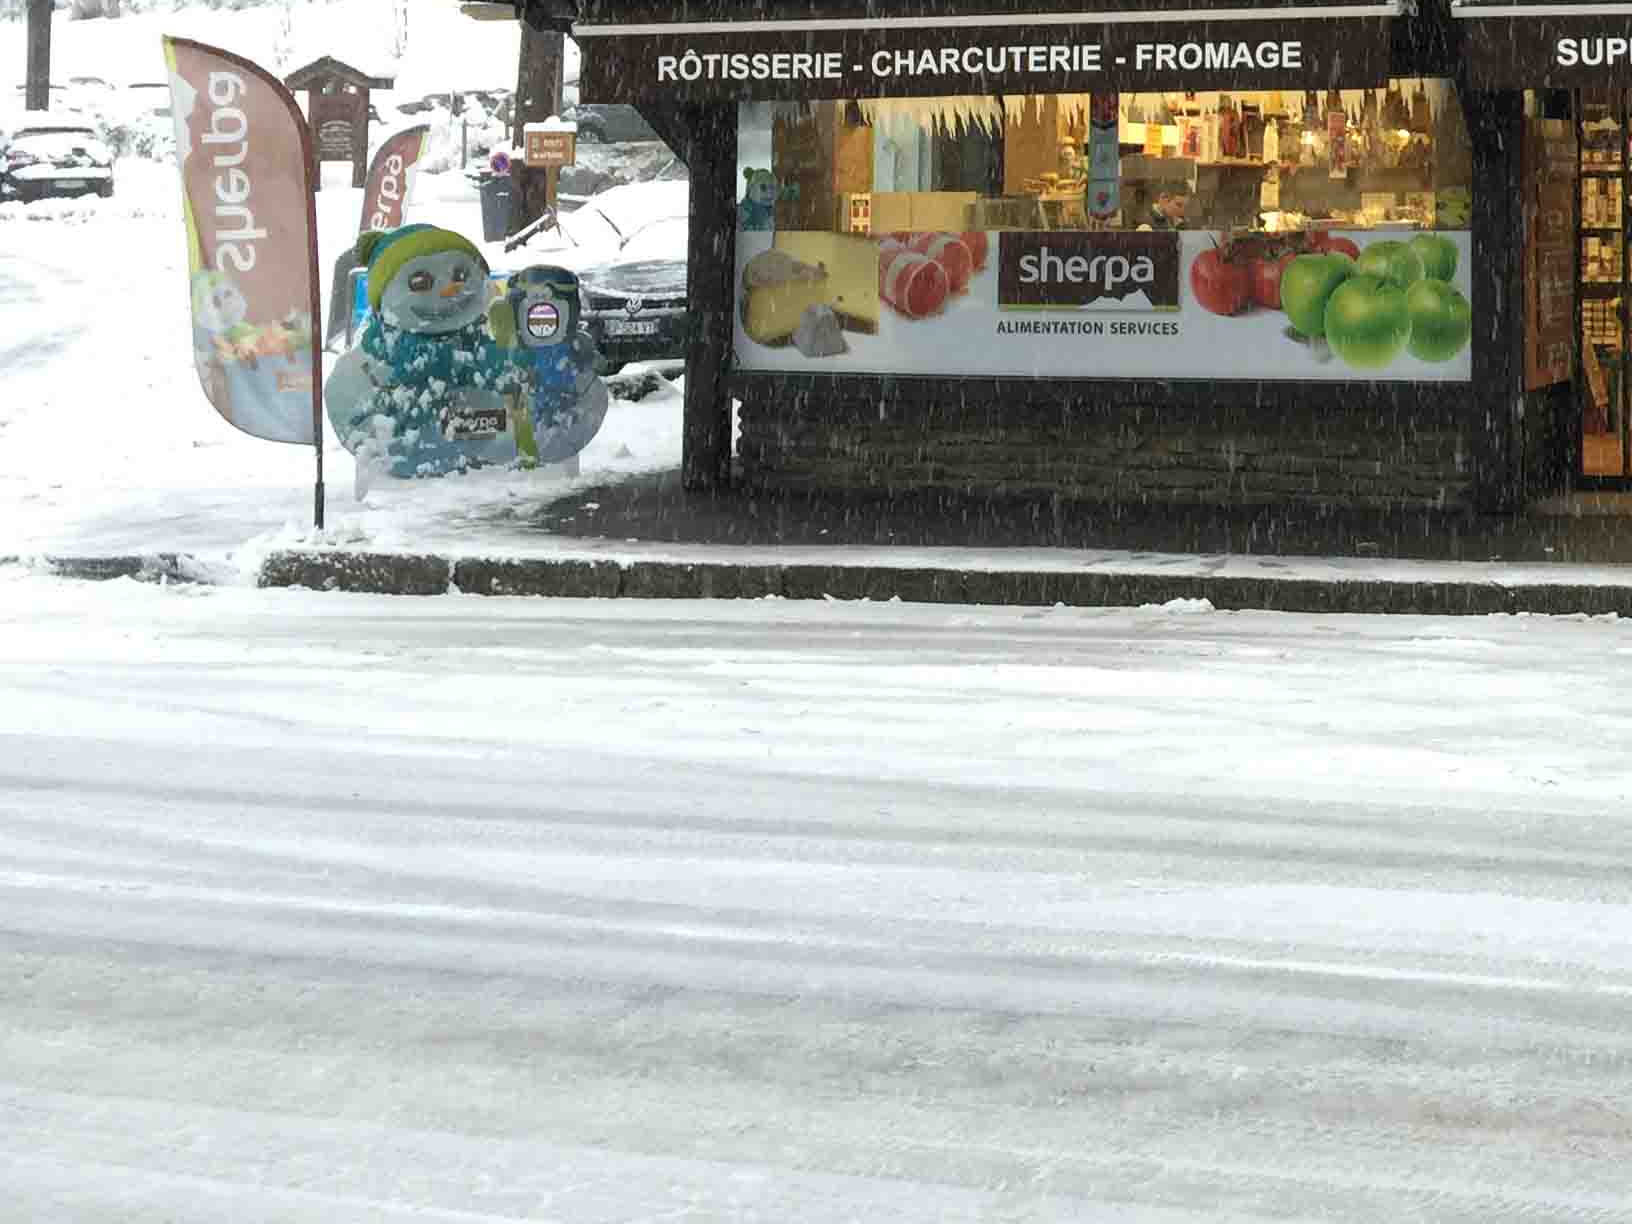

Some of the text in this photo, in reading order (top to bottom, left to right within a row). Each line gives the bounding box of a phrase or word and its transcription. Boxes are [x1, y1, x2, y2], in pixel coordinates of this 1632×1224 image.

[657, 48, 843, 81] RÔTISSERIE
[871, 45, 1102, 77] CHARCUTERIE
[1135, 40, 1301, 71] FROMAGE
[370, 153, 403, 231] erpa
[1019, 246, 1154, 290] sherpa
[997, 319, 1179, 336] ALIMENTATION SERVICES
